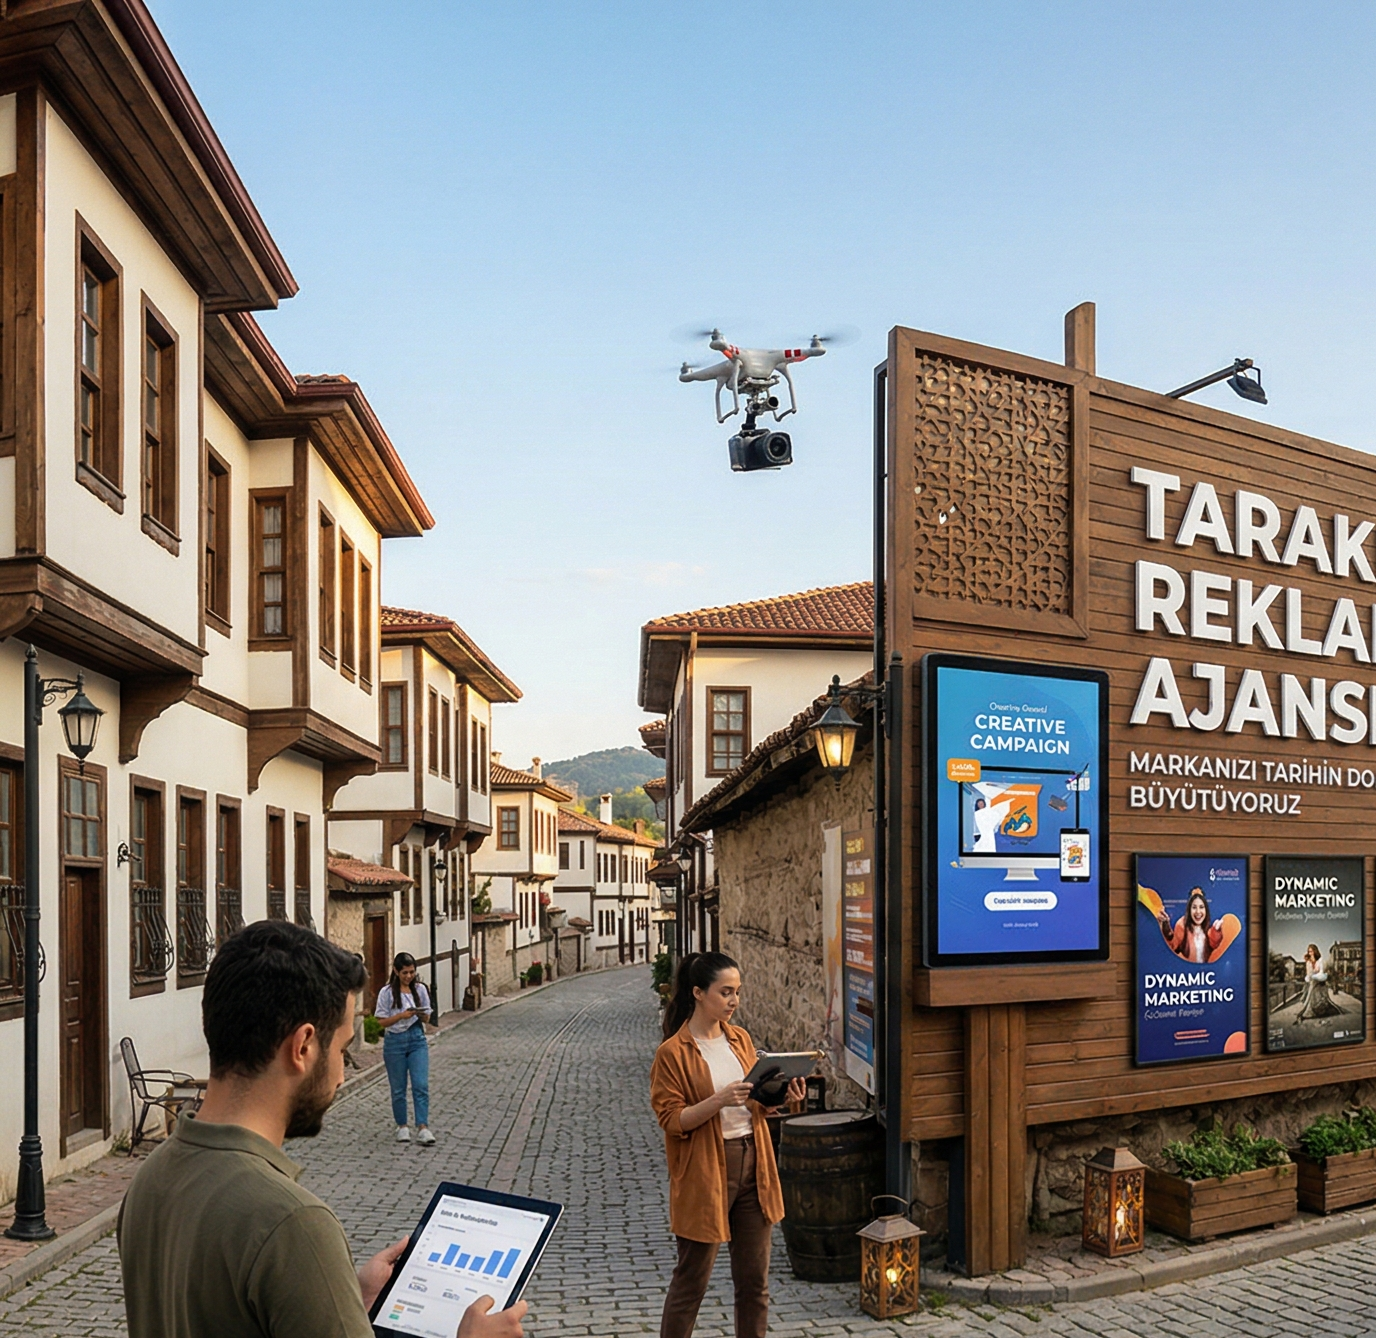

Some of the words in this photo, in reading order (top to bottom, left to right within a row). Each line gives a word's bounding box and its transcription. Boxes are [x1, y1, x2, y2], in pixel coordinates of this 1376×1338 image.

[975, 714, 1066, 735] CREATIVE
[970, 733, 1070, 755] CAMPAIGN
[1130, 751, 1257, 782] MARKANIZI
[1262, 758, 1342, 786] TARİHİN
[1130, 780, 1301, 814] BÜYÜTÜYORUZ
[1275, 877, 1338, 891] DYNAMIC
[1275, 893, 1355, 908] MARKETING
[1144, 971, 1216, 989] DYNAMIC
[1144, 988, 1234, 1007] MARKETING
